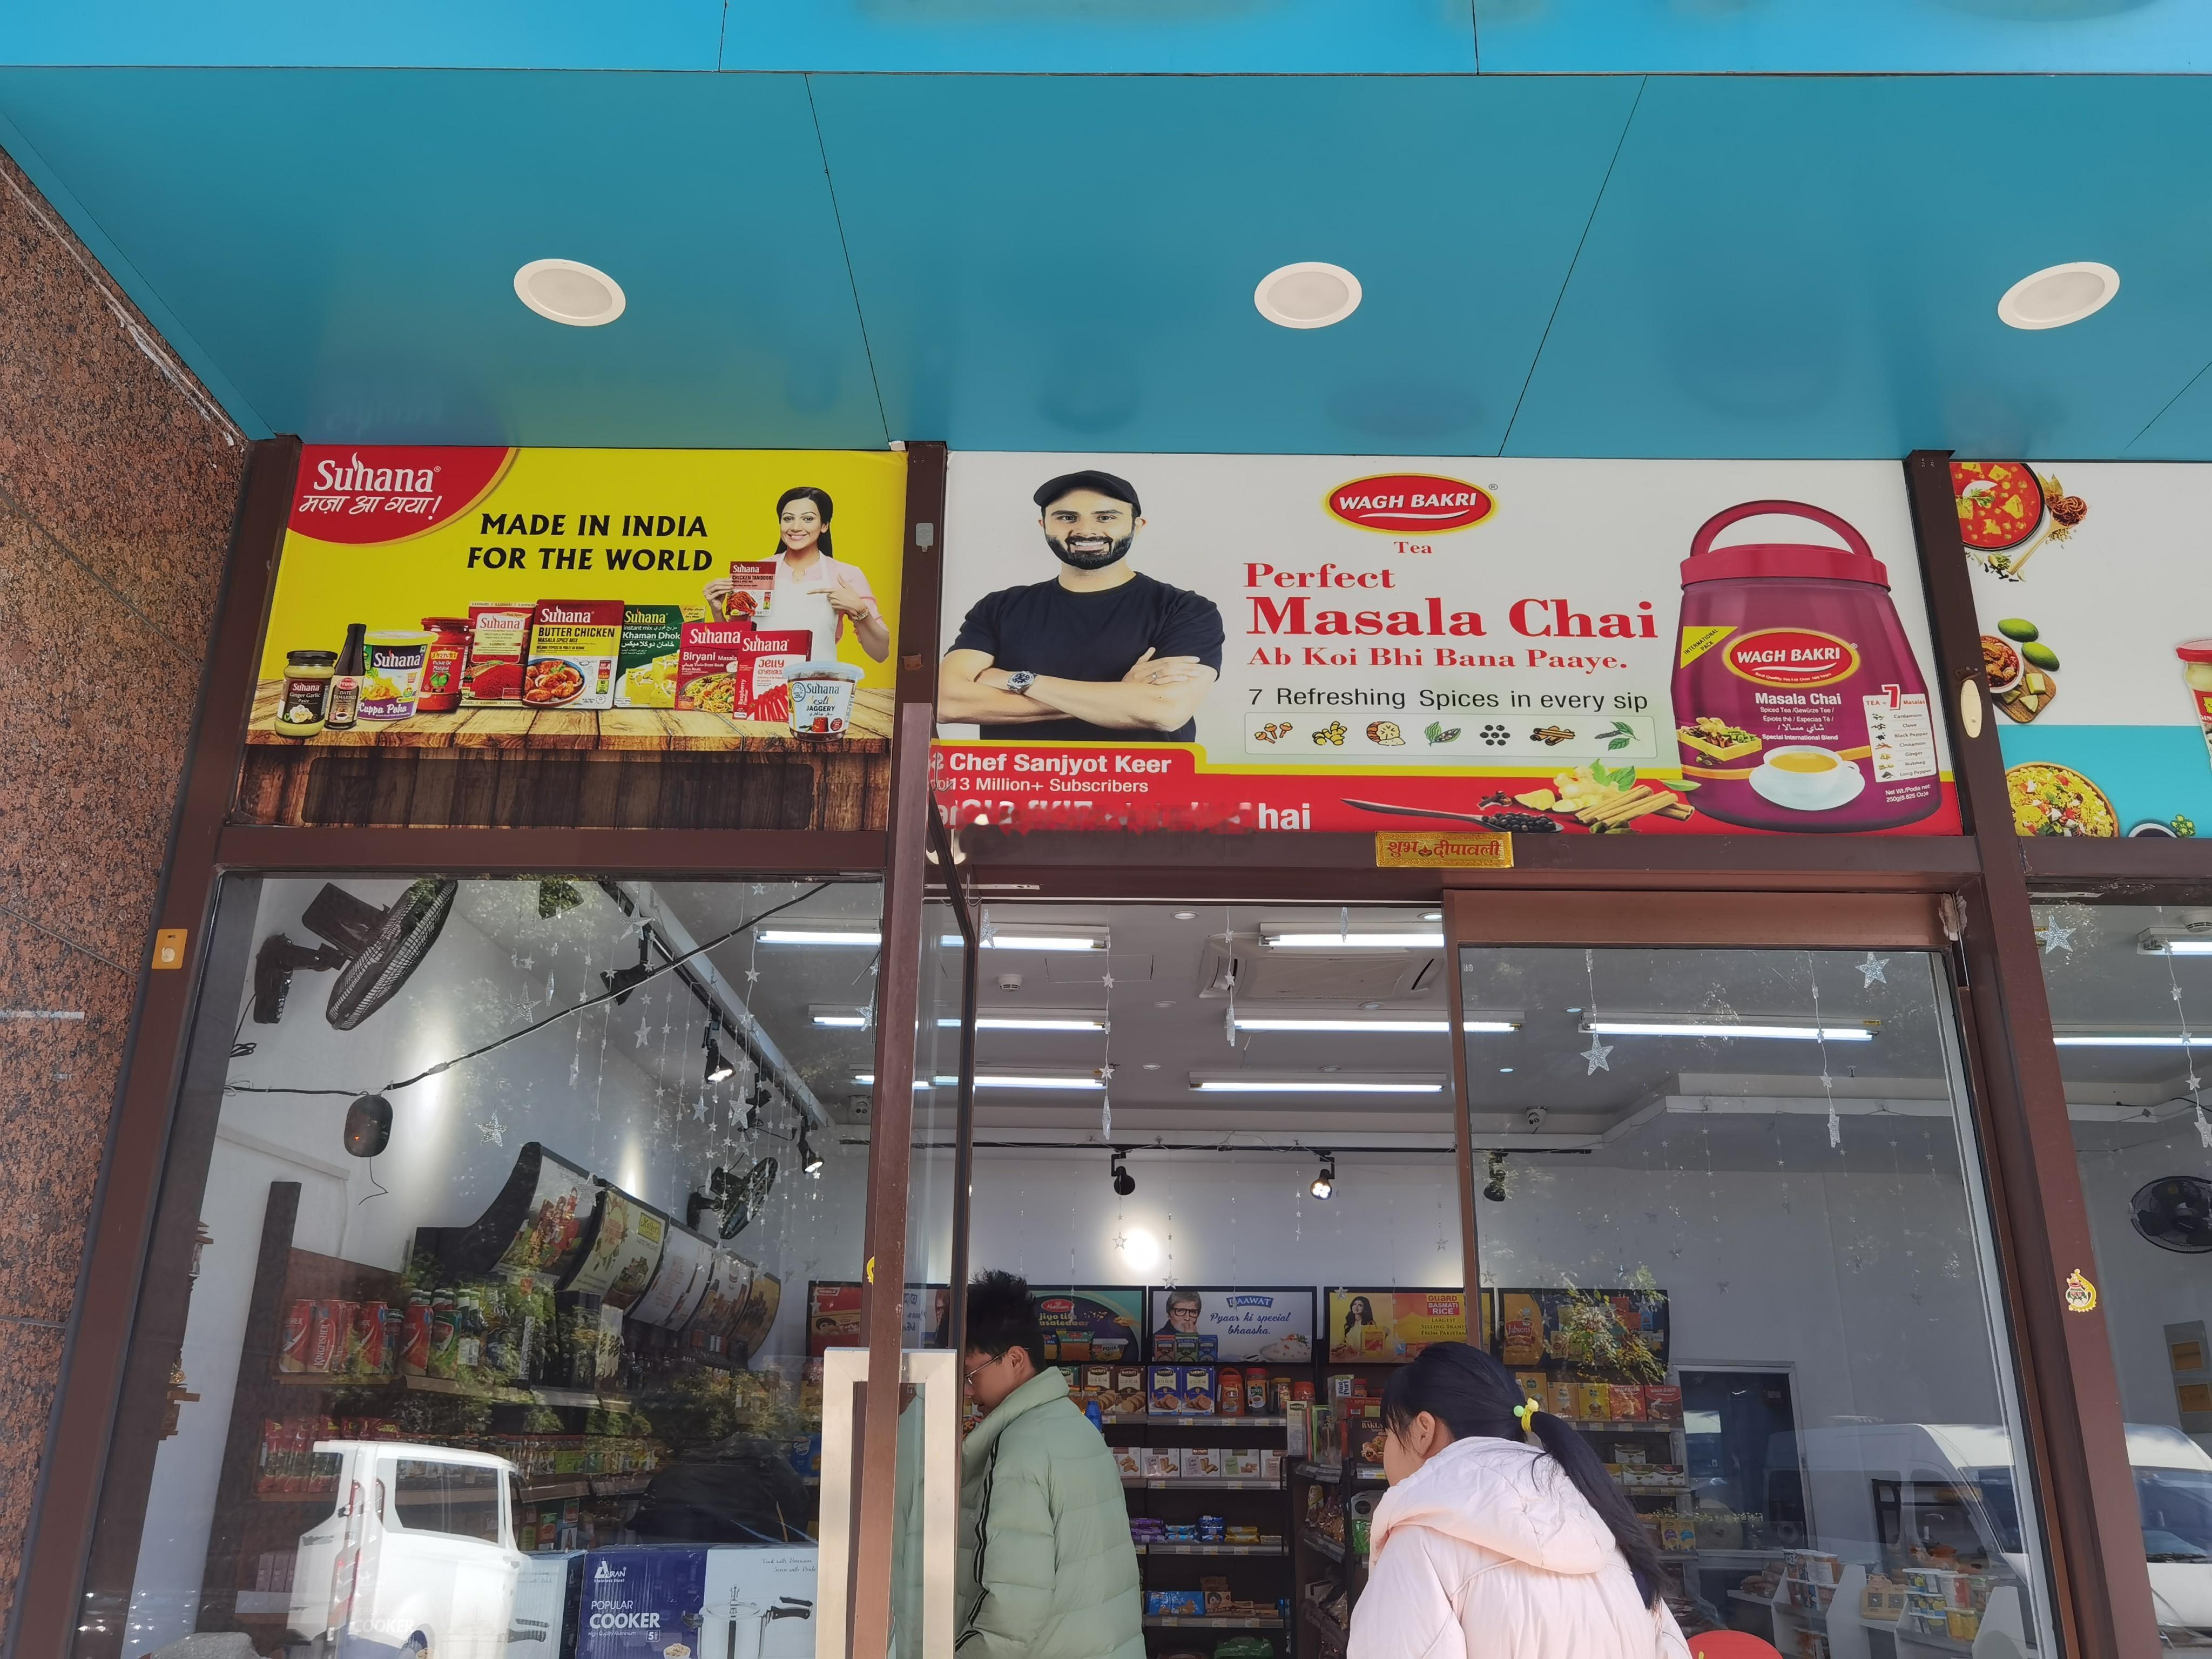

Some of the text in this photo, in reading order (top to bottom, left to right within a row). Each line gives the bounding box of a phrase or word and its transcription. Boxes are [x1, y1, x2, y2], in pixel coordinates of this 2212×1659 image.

[313, 452, 433, 493] Suhana
[299, 495, 443, 520] मज़ा आ गया!
[1339, 492, 1476, 510] WAGH BAKRI
[480, 514, 709, 537] MADE IN INDIA
[1393, 541, 1433, 555] Tea
[467, 547, 712, 571] FOR THE WORLD
[732, 563, 759, 573] Suhana
[1243, 563, 1395, 589] Perfect
[480, 615, 520, 629] Suhana
[541, 605, 591, 623] Suhana
[624, 608, 666, 623] Suhana
[1245, 596, 1658, 638] Masala Chai
[538, 627, 615, 637] BUTTER CHICKEN
[689, 625, 740, 644] Suhana
[742, 635, 788, 651] Suhana
[1683, 629, 1719, 655] INTERNATIONAL
[1701, 640, 1714, 651] PACK
[374, 650, 420, 667] Suhana
[683, 651, 716, 663] Biryani
[1247, 646, 1627, 674] Ab Koi Bhi Bana Paaye.
[1737, 648, 1840, 663] WAGH BAKRI
[293, 683, 320, 692] Suhana
[738, 679, 746, 705] Raspberry
[806, 682, 839, 694] Suhana
[1249, 687, 1648, 712] 7 Refreshing Spices in every sip
[1755, 693, 1842, 705] Masala Chai
[359, 702, 407, 713] Cuppa Poha
[949, 753, 1007, 771] Chef
[1014, 754, 1108, 775] Sanjyot
[1115, 756, 1172, 773] Keer
[976, 778, 1044, 791] Million+
[1050, 779, 1149, 792] Subscribers
[1387, 839, 1501, 858] शुभ दीपावली
[1039, 1313, 1059, 1321] jiyo
[1210, 1312, 1291, 1324] Pyaar ki special
[1508, 1325, 1530, 1334] Jabsons
[314, 1323, 329, 1366] KINGFISHER
[591, 1600, 633, 1610] POPULAR
[589, 1613, 660, 1629] COOKER
[648, 1631, 654, 1640] 5
